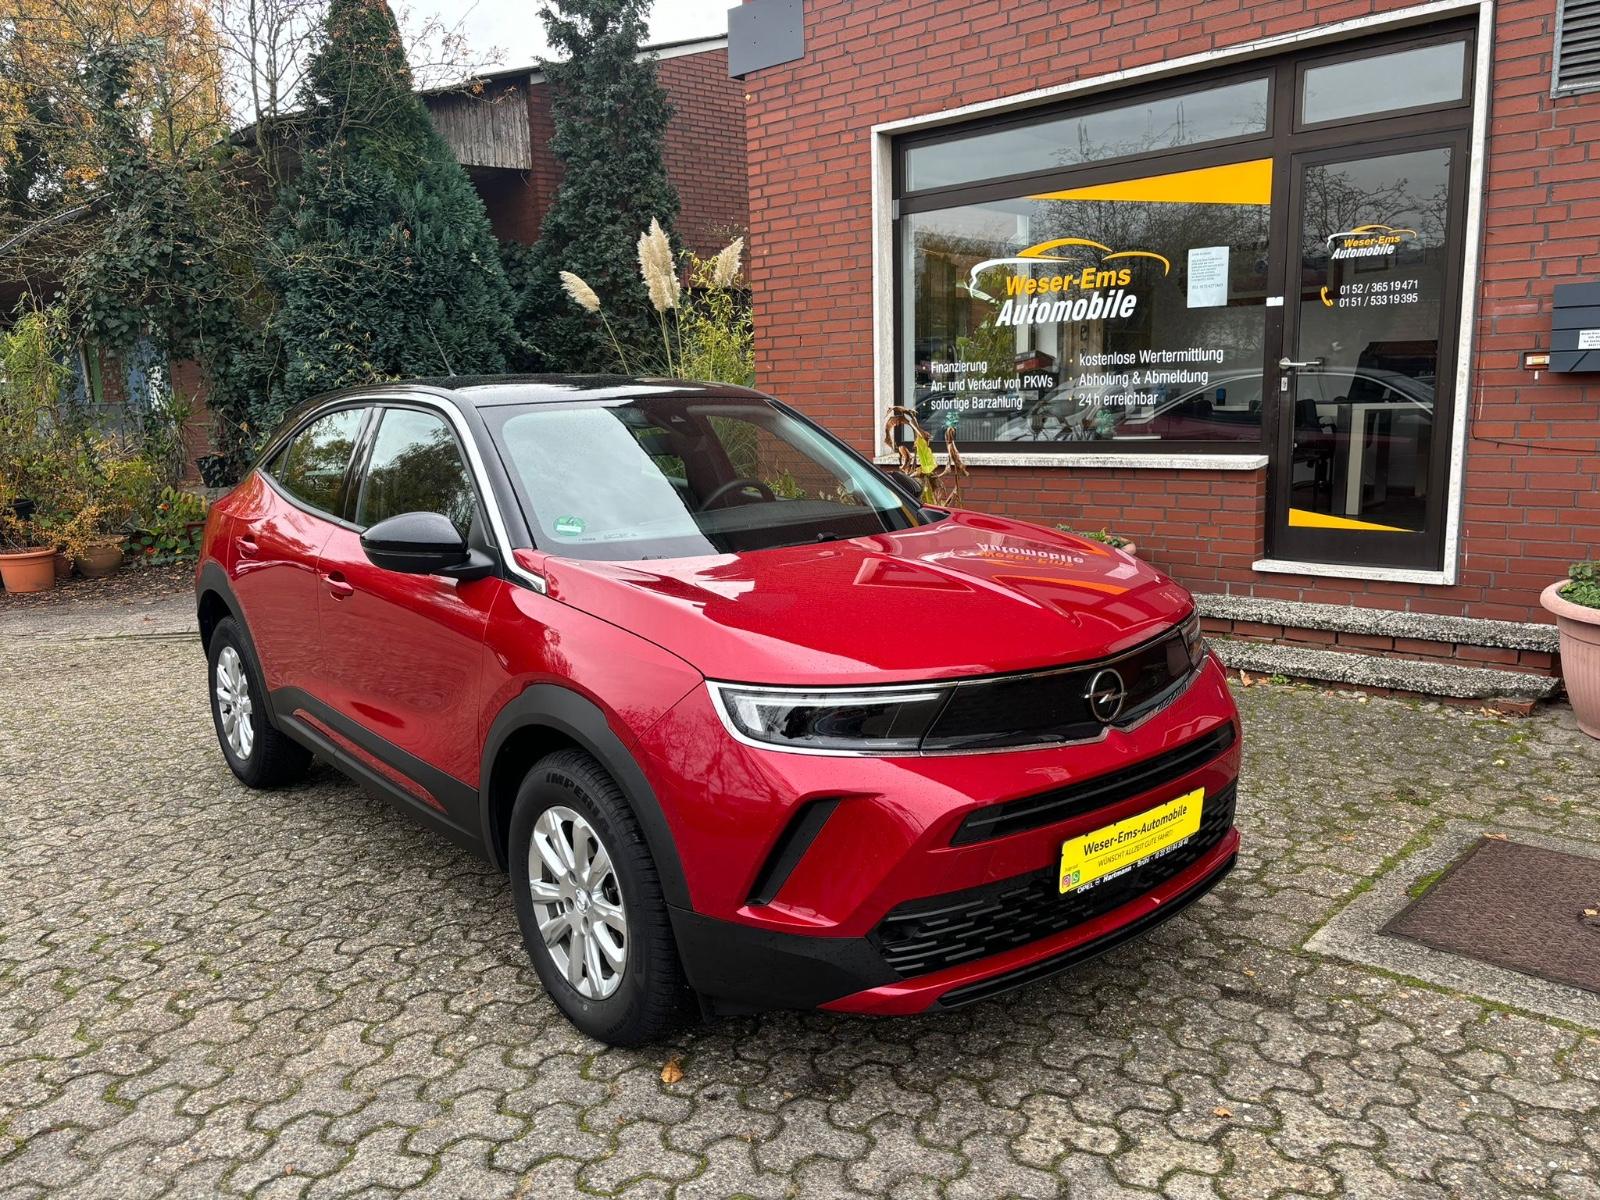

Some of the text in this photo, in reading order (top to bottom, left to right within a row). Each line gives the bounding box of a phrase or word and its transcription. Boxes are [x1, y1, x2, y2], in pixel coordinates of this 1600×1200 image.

[1344, 236, 1400, 247] Weser-Ems
[1331, 244, 1395, 259] Automobile
[1006, 267, 1132, 295] Weser-Ems
[995, 289, 1137, 327] Automobile
[1080, 347, 1223, 366] kostenlose Wertermittlung
[931, 360, 988, 374] Finanzierung
[930, 374, 1053, 392] An- und Verkauf von PKWs
[1079, 370, 1208, 387] Abholung & Abmeldung
[931, 396, 1022, 411] sofortige Barzahlung
[1104, 392, 1158, 406] erreichbar
[1084, 805, 1188, 856] Weser-Ems-Automobile
[1077, 882, 1094, 894] OPEL
[1103, 866, 1132, 882] Hartmann
